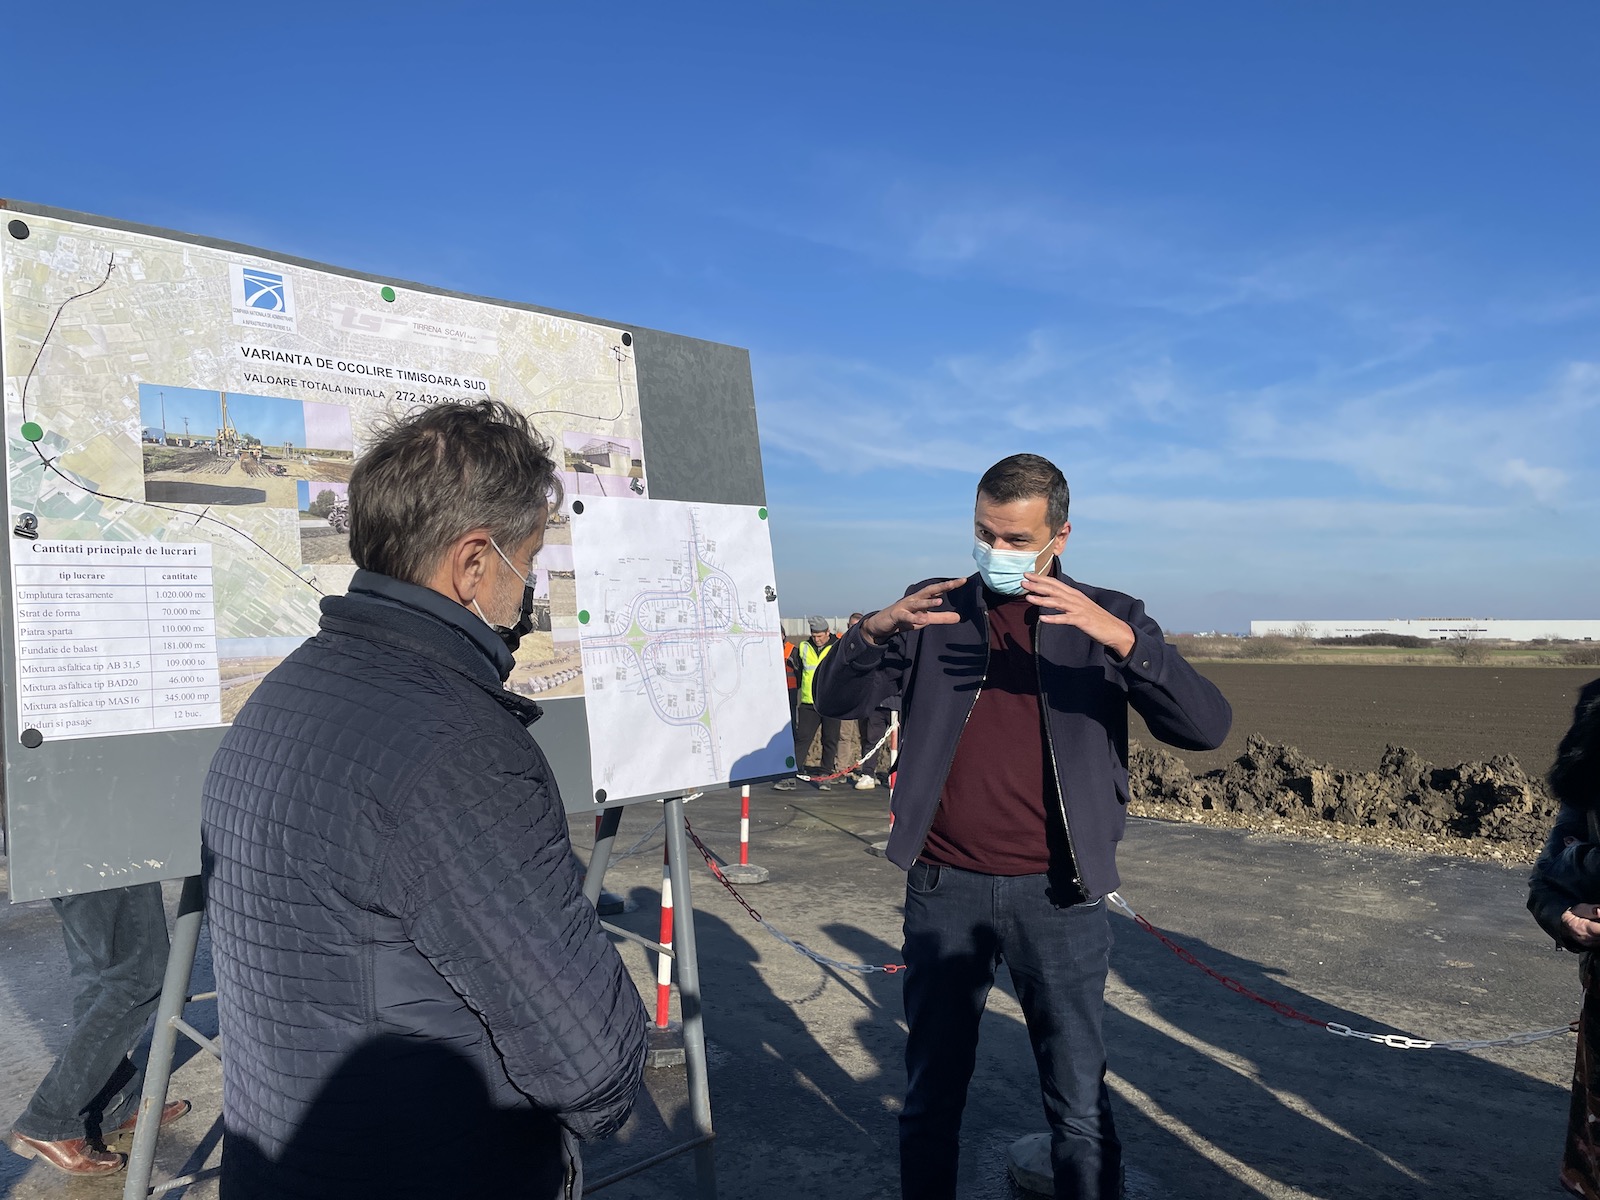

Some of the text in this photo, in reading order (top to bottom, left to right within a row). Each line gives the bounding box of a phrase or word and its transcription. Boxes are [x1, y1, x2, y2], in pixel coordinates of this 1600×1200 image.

[413, 322, 442, 334] TIRRENA
[444, 328, 466, 338] SCAVI
[240, 346, 486, 391] VARIANTA DE OCOLIRE TIMISOARA SUD
[244, 372, 298, 387] VALOARE
[300, 380, 342, 393] TOTALA
[344, 386, 386, 399] INITIALA
[32, 543, 197, 556] Cantitati principale de lucrari
[59, 572, 71, 581] tip
[18, 591, 63, 600] Umplutura
[19, 610, 41, 618] Strat
[47, 629, 73, 637] sparta
[21, 646, 58, 654] Fundatie
[22, 665, 55, 673] Mixtura
[58, 663, 91, 672] asfaltica
[93, 663, 104, 672] tip
[123, 661, 140, 670] 31,5
[23, 679, 138, 692] Mixtura asfaltica tip BAD20
[164, 693, 195, 702] 345.000
[24, 697, 140, 711] Mixtura asfaltica tip MAS16
[24, 720, 54, 730] Poduri
[66, 719, 92, 728] pasaje
